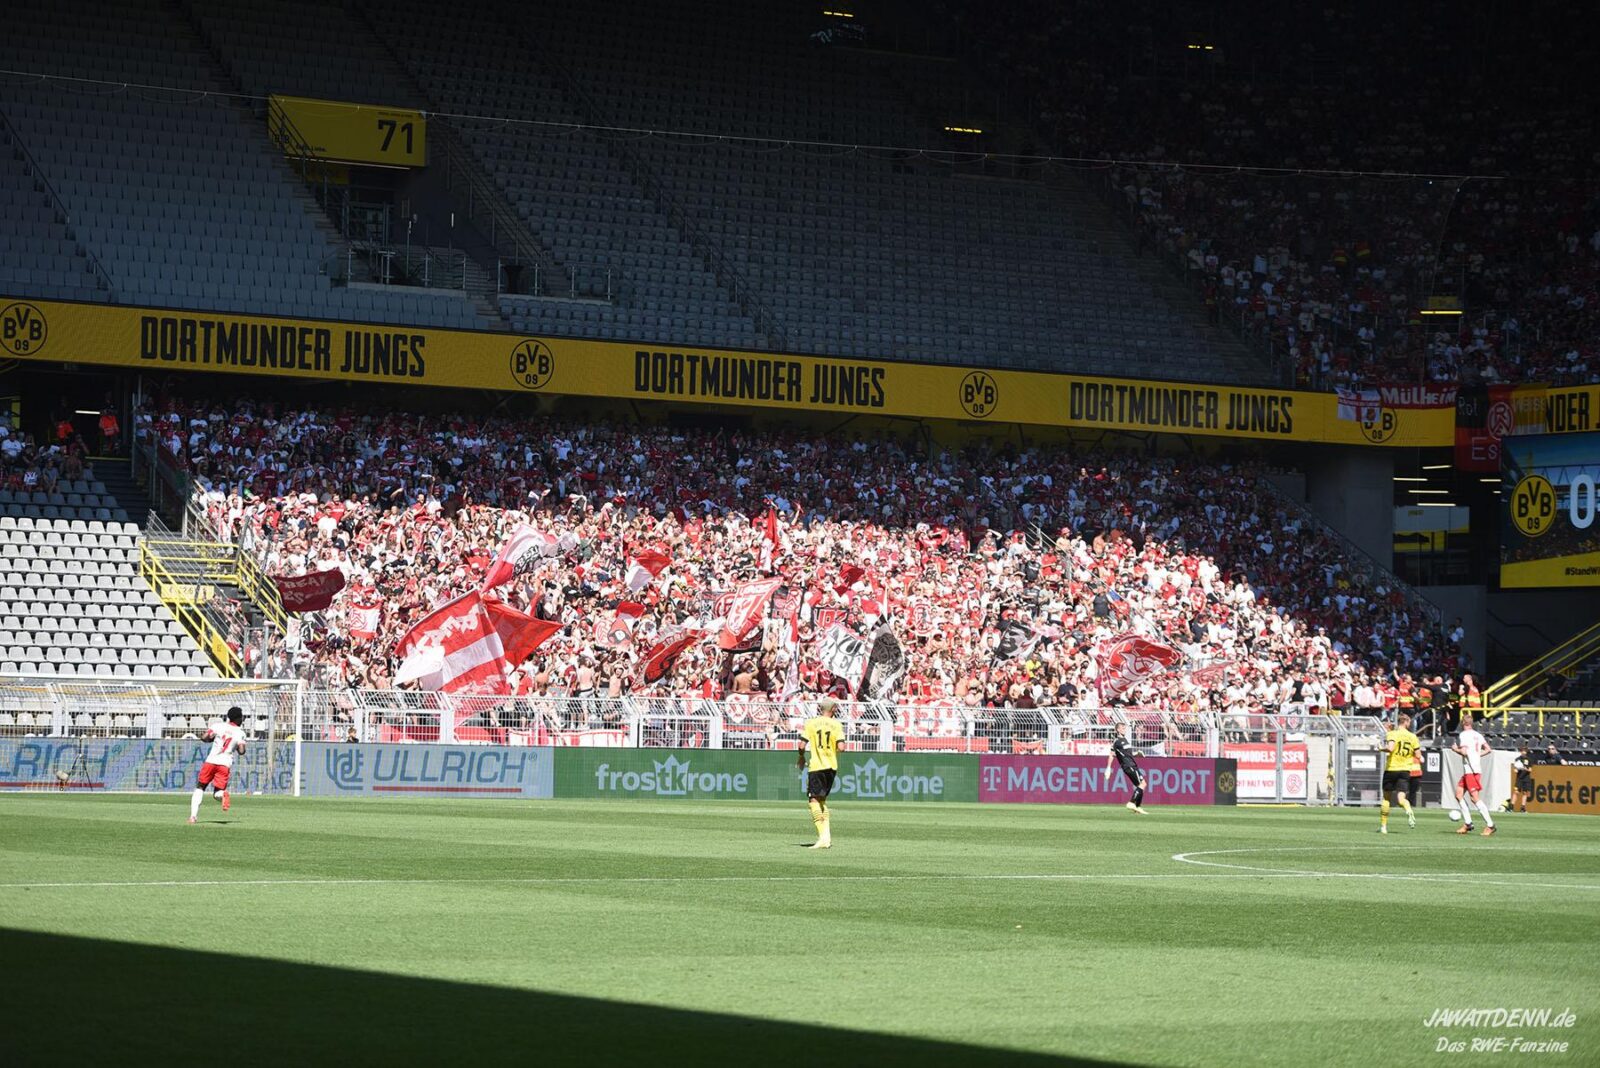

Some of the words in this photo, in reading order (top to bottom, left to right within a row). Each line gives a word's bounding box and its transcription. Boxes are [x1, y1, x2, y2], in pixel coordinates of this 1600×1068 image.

[378, 119, 413, 154] 71
[3, 307, 43, 341] BVB
[14, 339, 30, 351] 09
[140, 316, 331, 372] DORTMUNDER
[340, 331, 425, 378] JUNGS
[516, 344, 550, 376] BVB
[524, 373, 539, 385] 09
[634, 351, 801, 402] DORTMUNDER
[810, 364, 886, 408] JUNGS
[964, 375, 995, 405] BVB
[972, 403, 985, 414] 09
[1070, 381, 1219, 430] DORTMUNDER
[1225, 393, 1293, 434] JUNGS
[1371, 429, 1383, 441] 09
[1517, 480, 1552, 518] BVB
[1569, 473, 1596, 529] 0
[1527, 517, 1540, 530] 09
[143, 742, 296, 765] ANLANBAU
[816, 729, 831, 749] 11
[1396, 741, 1411, 757] 15
[1282, 750, 1305, 763] SSEN
[135, 769, 186, 789] UND
[594, 762, 749, 793] frostkrone
[798, 765, 944, 795] fostkrone
